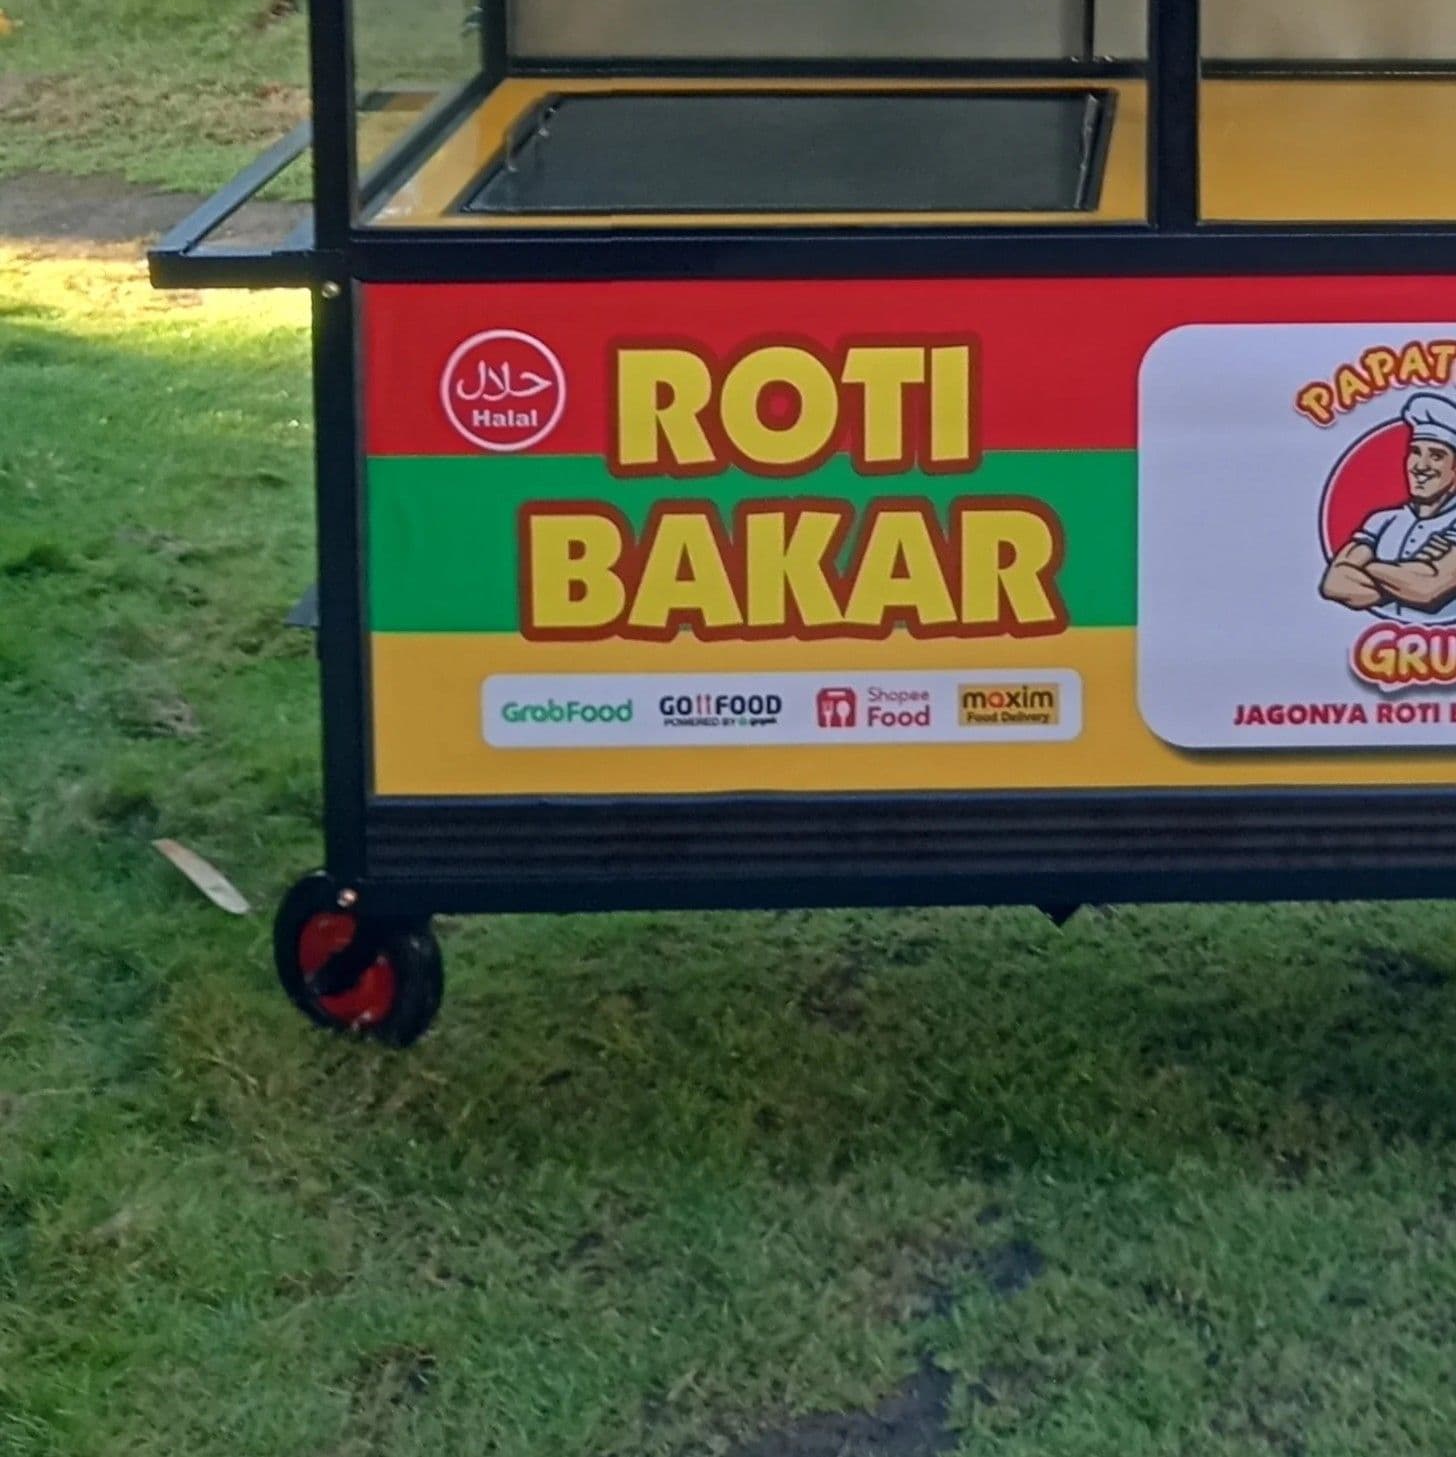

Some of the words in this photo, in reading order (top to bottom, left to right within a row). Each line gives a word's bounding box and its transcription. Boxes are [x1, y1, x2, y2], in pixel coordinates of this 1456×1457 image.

[616, 345, 971, 466] ROTI
[472, 409, 538, 427] Halal
[529, 509, 1057, 629] BAKAR
[866, 686, 930, 707] Shopee
[962, 685, 1054, 710] maxim
[501, 699, 633, 723] GrabFood
[867, 705, 930, 728] Food
[967, 712, 997, 723] Food
[1001, 711, 1050, 724] Delivery
[1232, 704, 1368, 725] JAGONYA
[1377, 704, 1440, 724] ROTI
